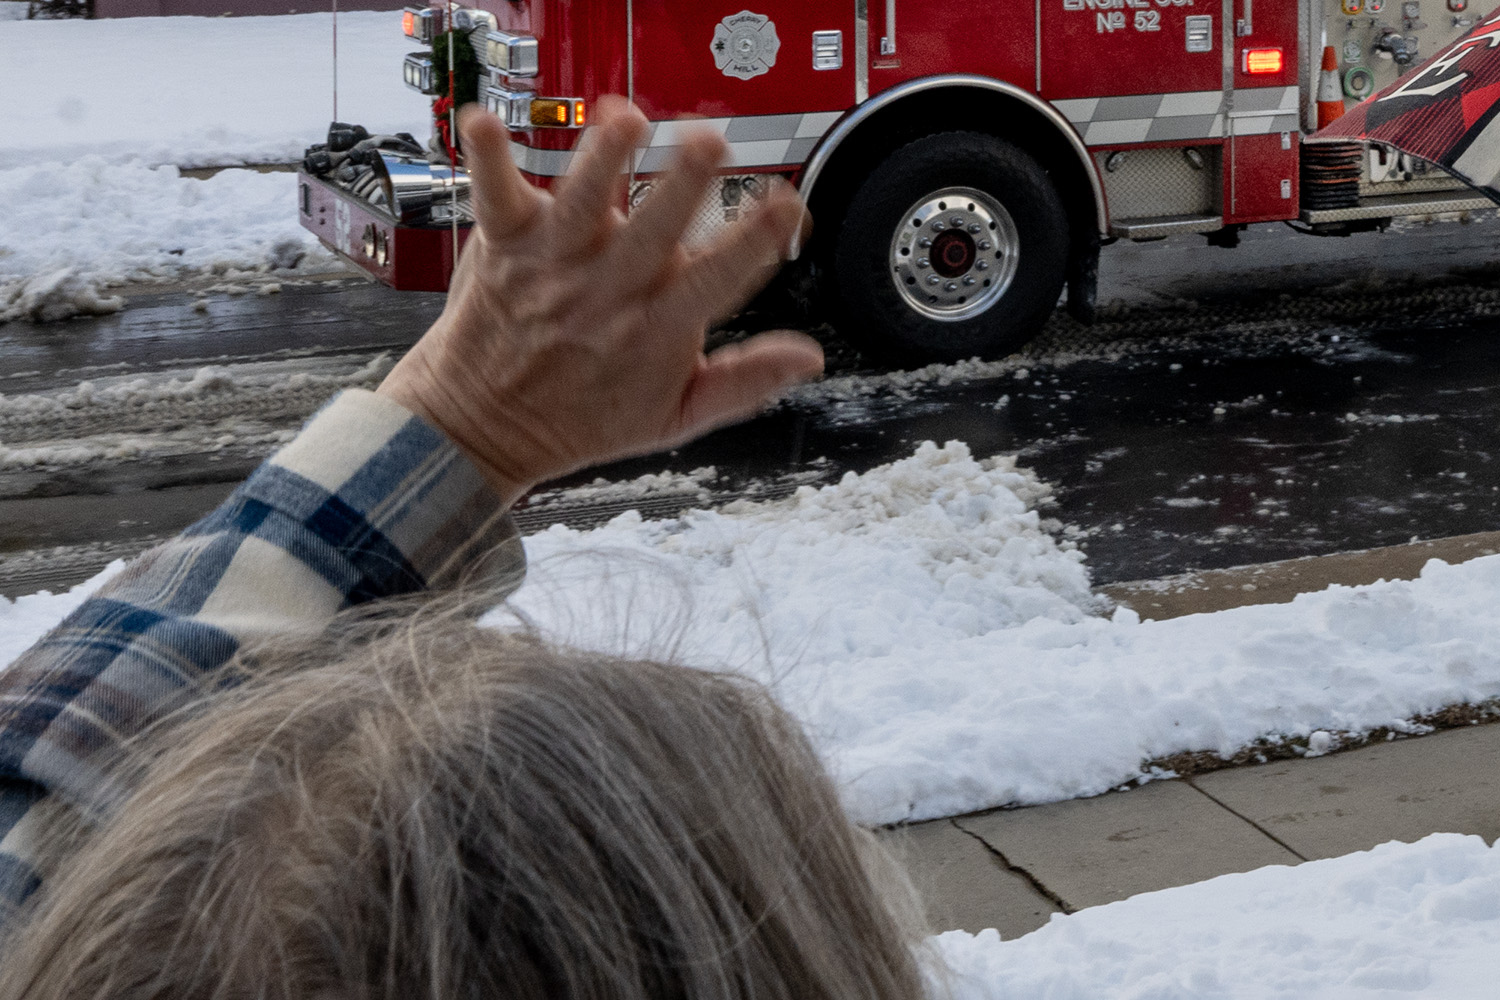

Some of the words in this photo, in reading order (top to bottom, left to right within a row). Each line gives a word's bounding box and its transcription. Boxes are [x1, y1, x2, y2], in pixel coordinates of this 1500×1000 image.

[729, 15, 761, 26] CHERRY
[1134, 10, 1161, 32] 52
[732, 64, 759, 73] HILL
